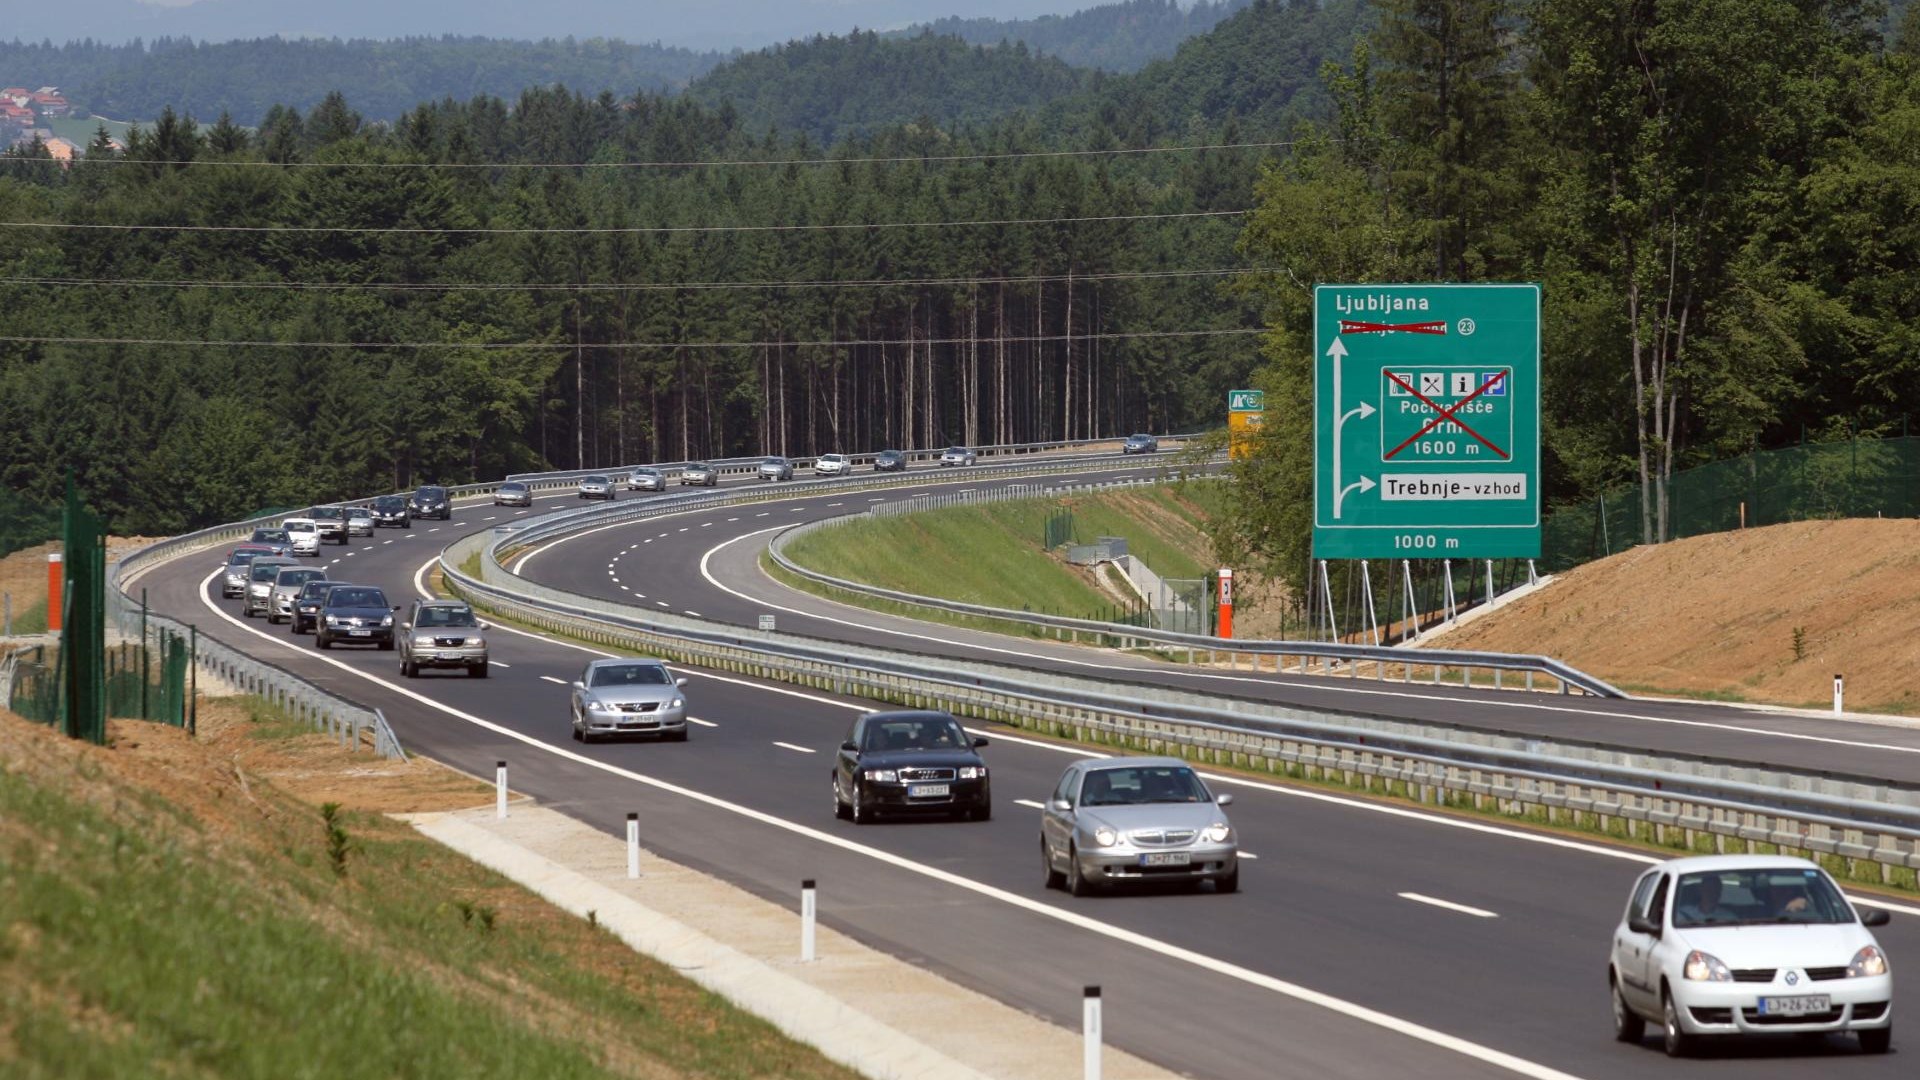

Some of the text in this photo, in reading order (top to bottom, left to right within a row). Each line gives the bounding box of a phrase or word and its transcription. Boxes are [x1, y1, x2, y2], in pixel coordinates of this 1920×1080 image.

[1336, 294, 1429, 314] Ljubljana
[1459, 321, 1473, 332] 23
[1414, 441, 1479, 455] 1600 m
[1394, 535, 1459, 548] 1000 m
